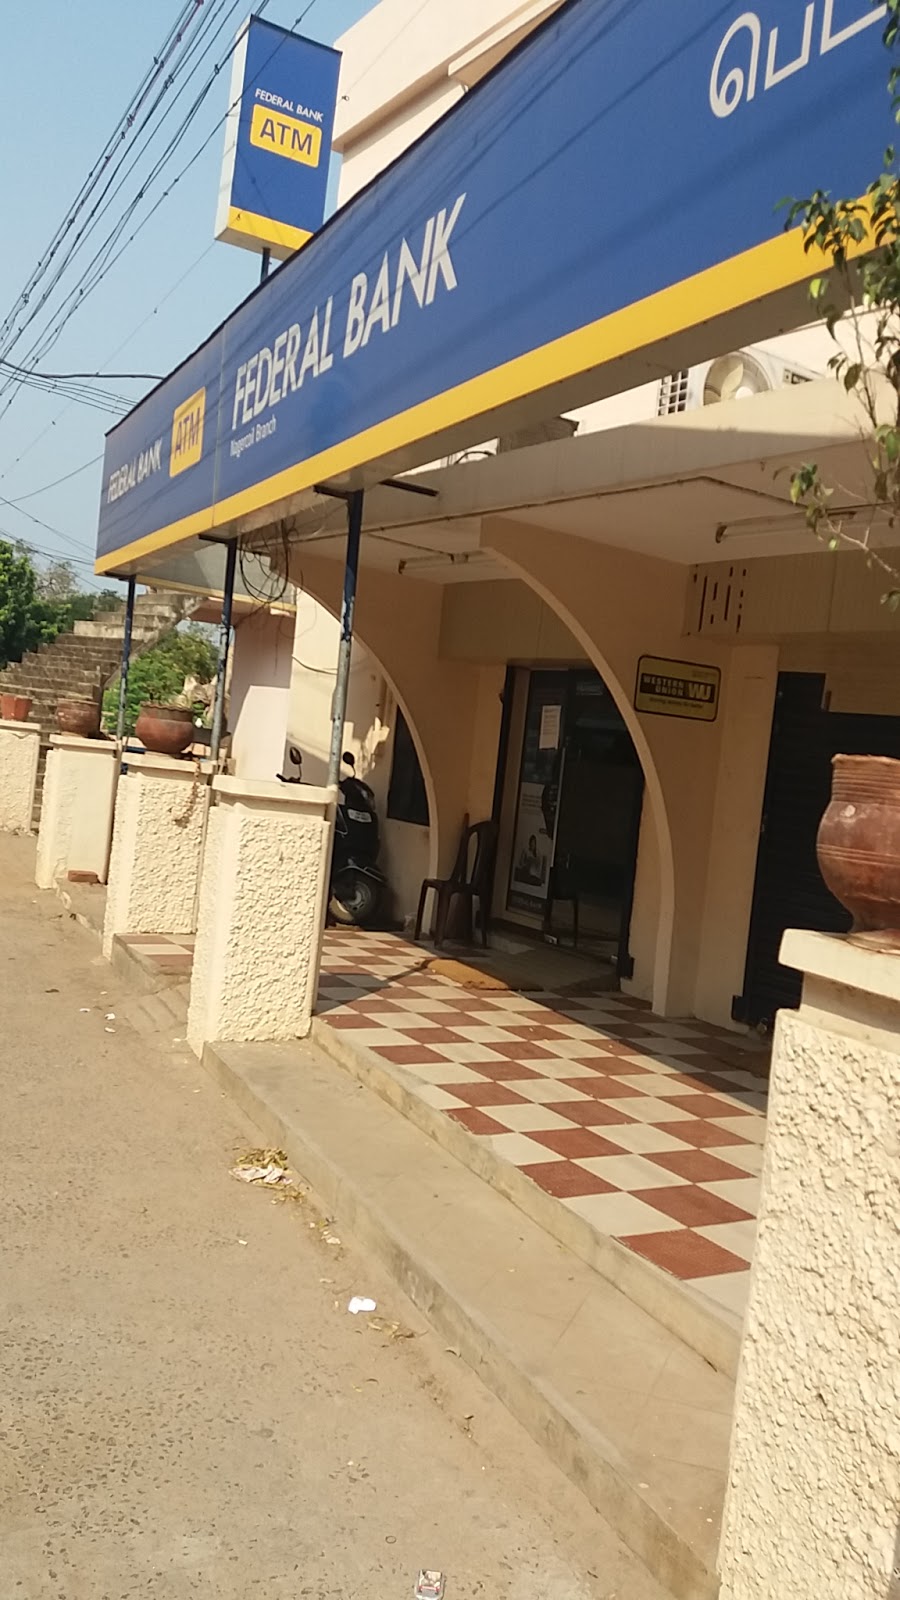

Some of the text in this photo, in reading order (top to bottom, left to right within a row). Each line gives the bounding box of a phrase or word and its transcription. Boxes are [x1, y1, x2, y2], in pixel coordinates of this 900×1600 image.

[255, 88, 324, 122] FEDERAL BANK
[260, 118, 312, 155] ATM
[232, 192, 467, 430] FEDERAL BANK
[174, 408, 200, 456] ATM
[256, 414, 276, 442] Branch
[107, 438, 162, 503] FEDERAL BANK
[643, 675, 683, 687] WESTERN
[655, 685, 684, 697] UNION
[688, 682, 712, 700] WU
